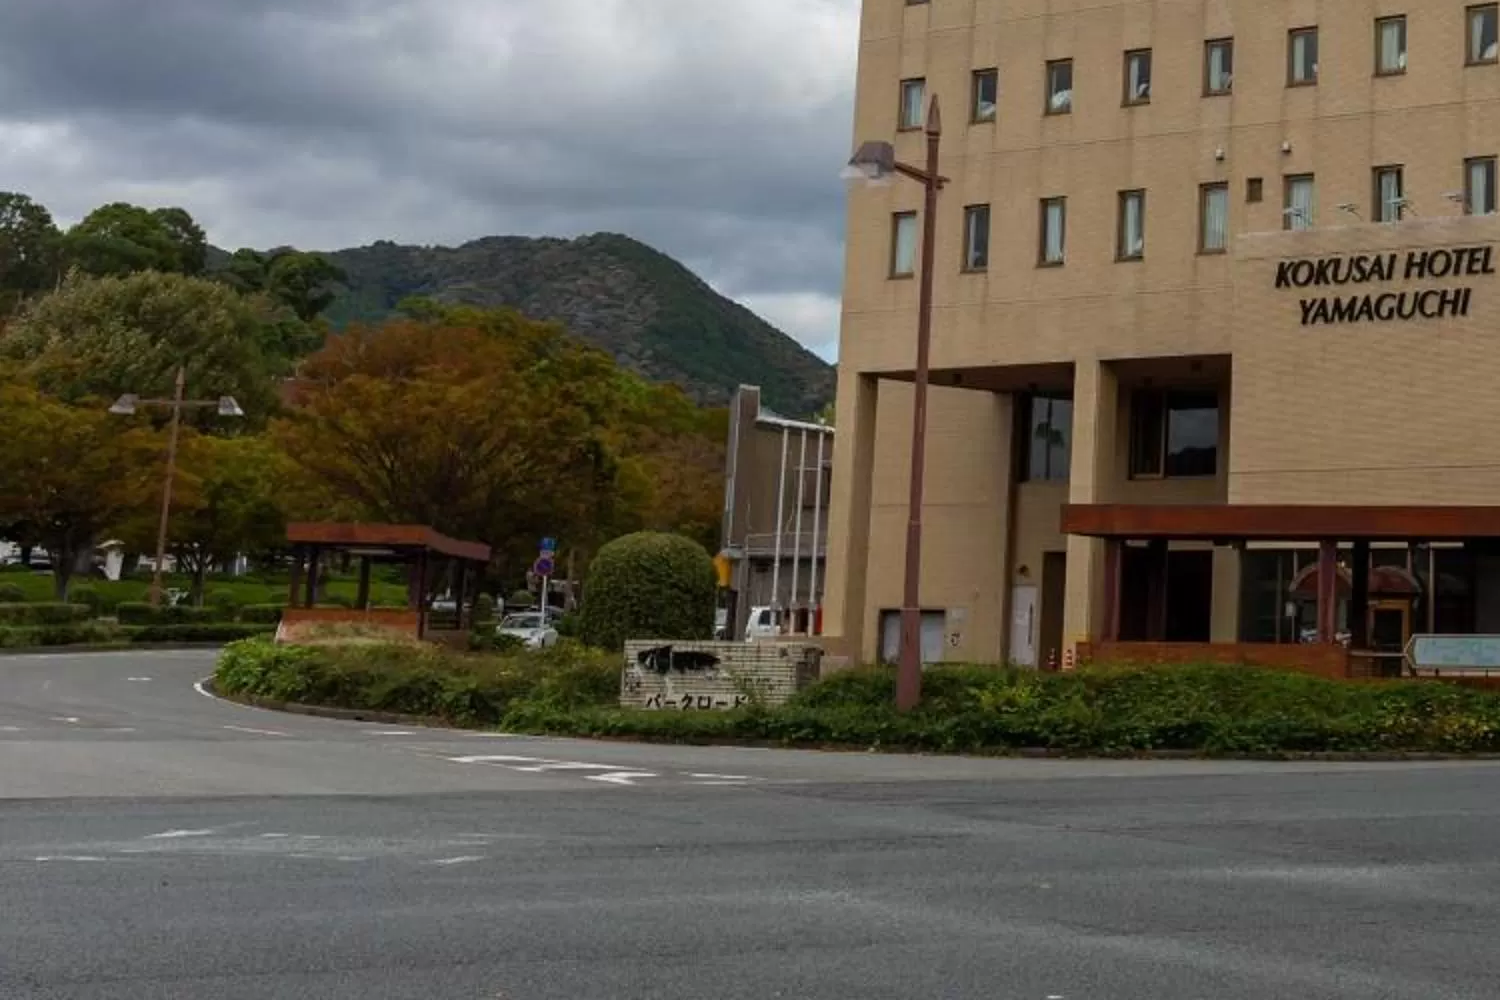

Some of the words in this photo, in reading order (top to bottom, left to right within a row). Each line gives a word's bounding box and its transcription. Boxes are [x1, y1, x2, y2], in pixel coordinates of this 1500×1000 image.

[1275, 254, 1396, 288] KOKUSAI
[1404, 247, 1495, 280] HOTEL
[1300, 288, 1472, 325] YAMAGUCHI
[646, 693, 748, 711] パークロード
